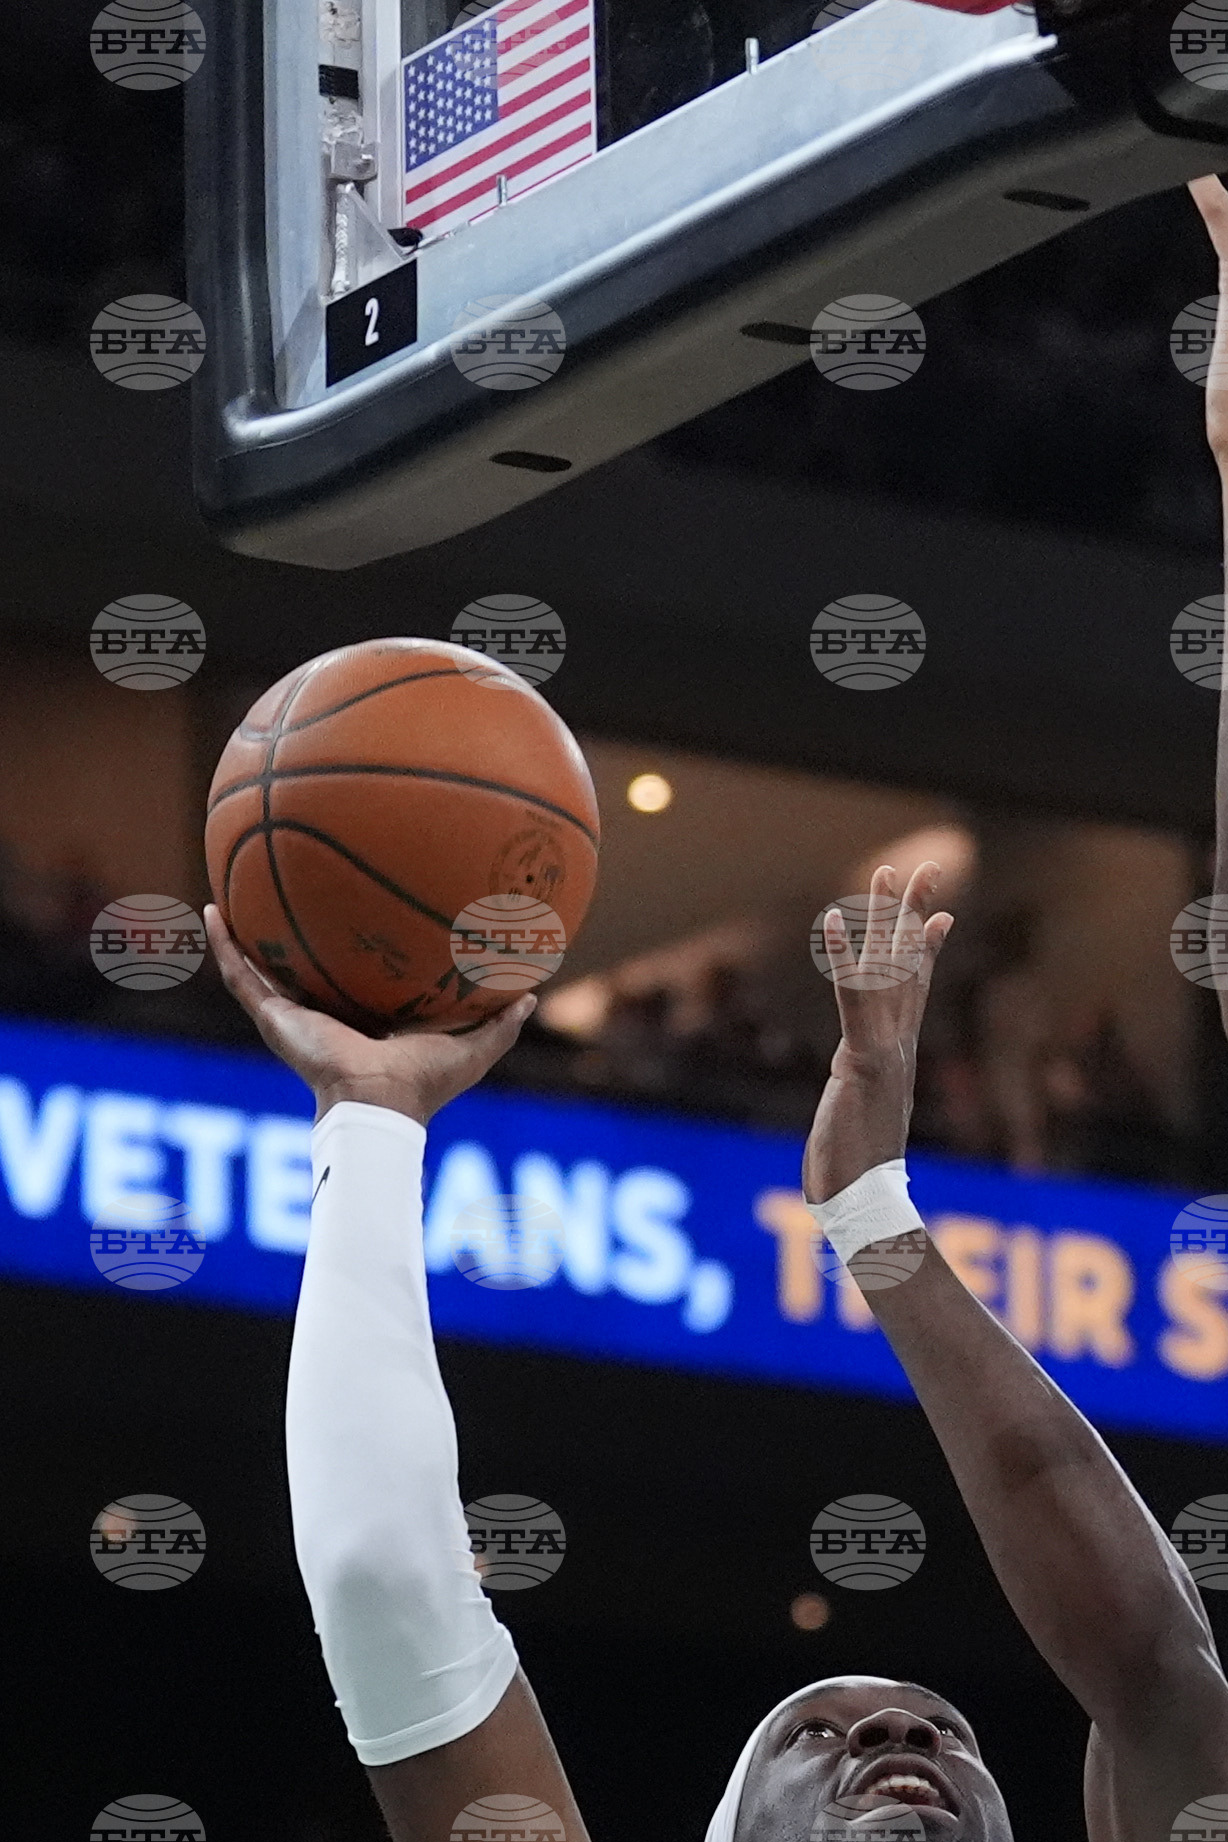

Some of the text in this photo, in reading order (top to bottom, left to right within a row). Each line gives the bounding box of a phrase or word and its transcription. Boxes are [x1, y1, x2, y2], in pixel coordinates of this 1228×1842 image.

[365, 297, 379, 346] 2
[0, 1077, 733, 1333] VETEANS,
[755, 1189, 1133, 1368] TEIR
